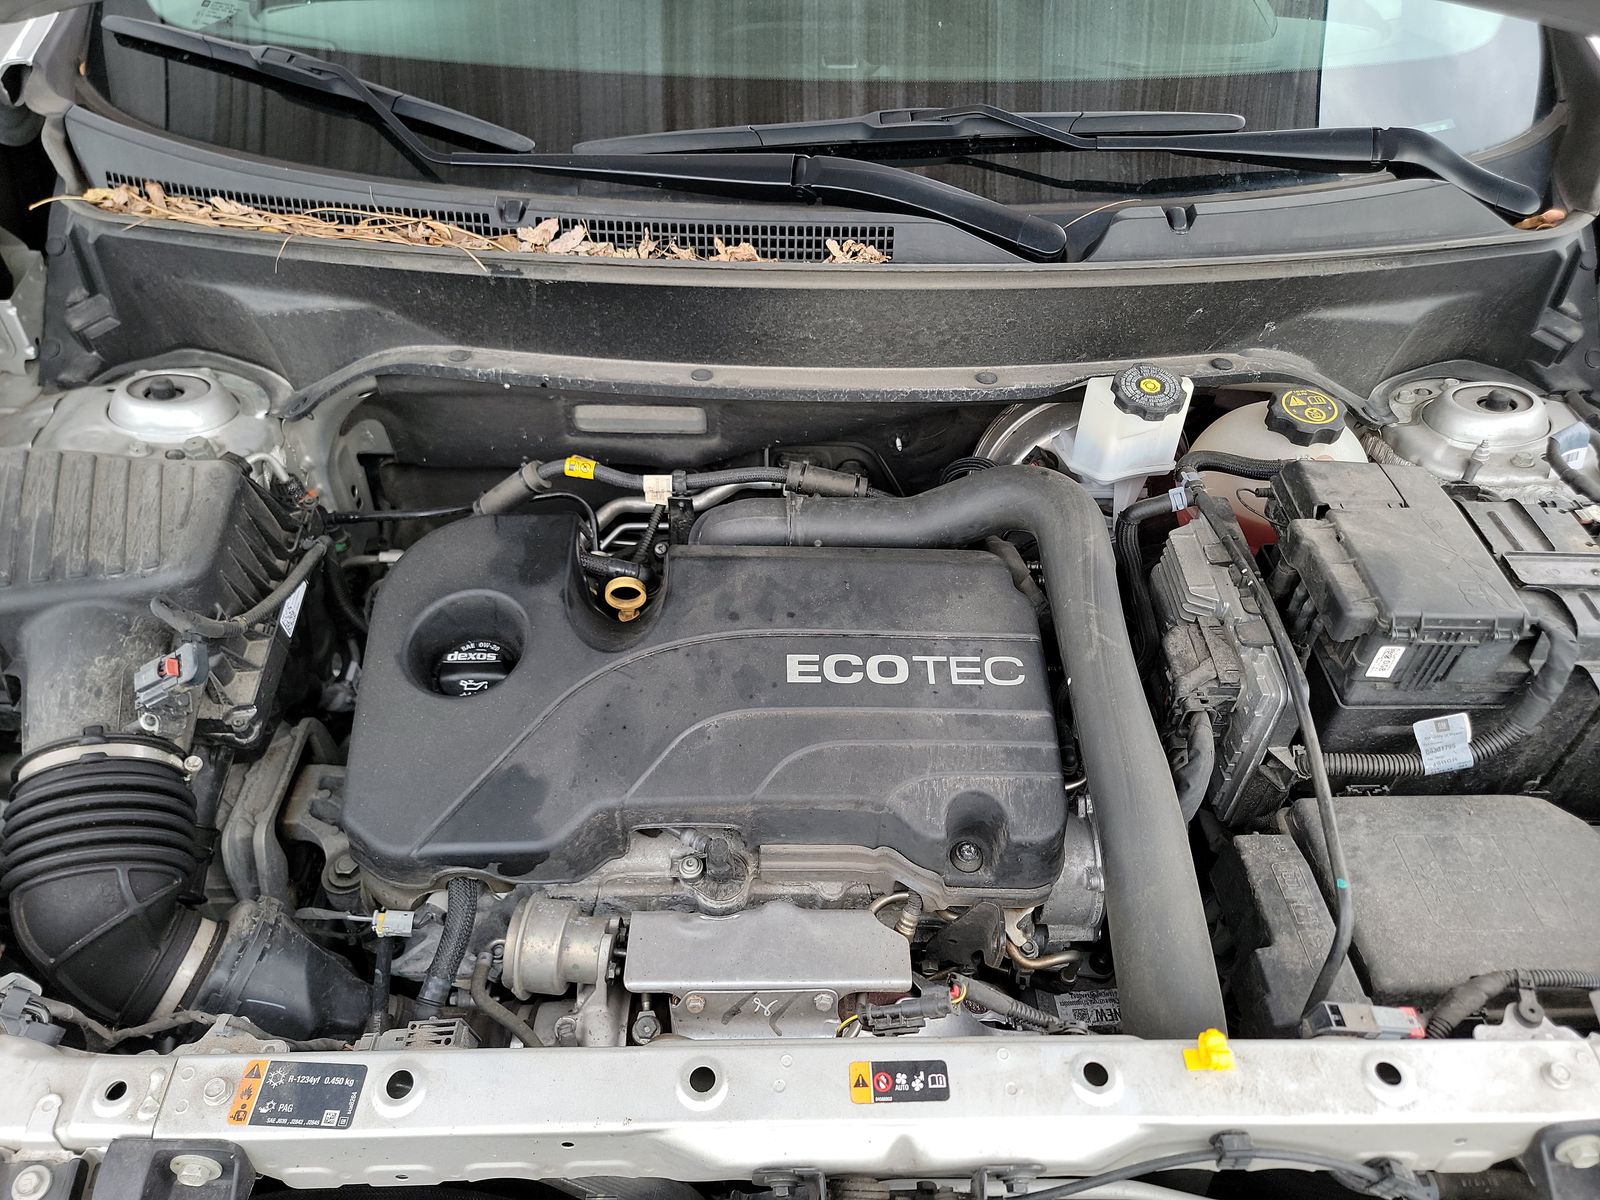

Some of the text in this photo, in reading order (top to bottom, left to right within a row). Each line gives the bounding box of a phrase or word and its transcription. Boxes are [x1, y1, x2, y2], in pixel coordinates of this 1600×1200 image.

[479, 642, 500, 652] 0W-20
[447, 651, 498, 661] dexos
[786, 653, 1026, 686] ECOTEC
[1095, 1008, 1121, 1022] NEW
[288, 1075, 355, 1087] R-1234yf 0.450 kg
[278, 1103, 293, 1113] PAG
